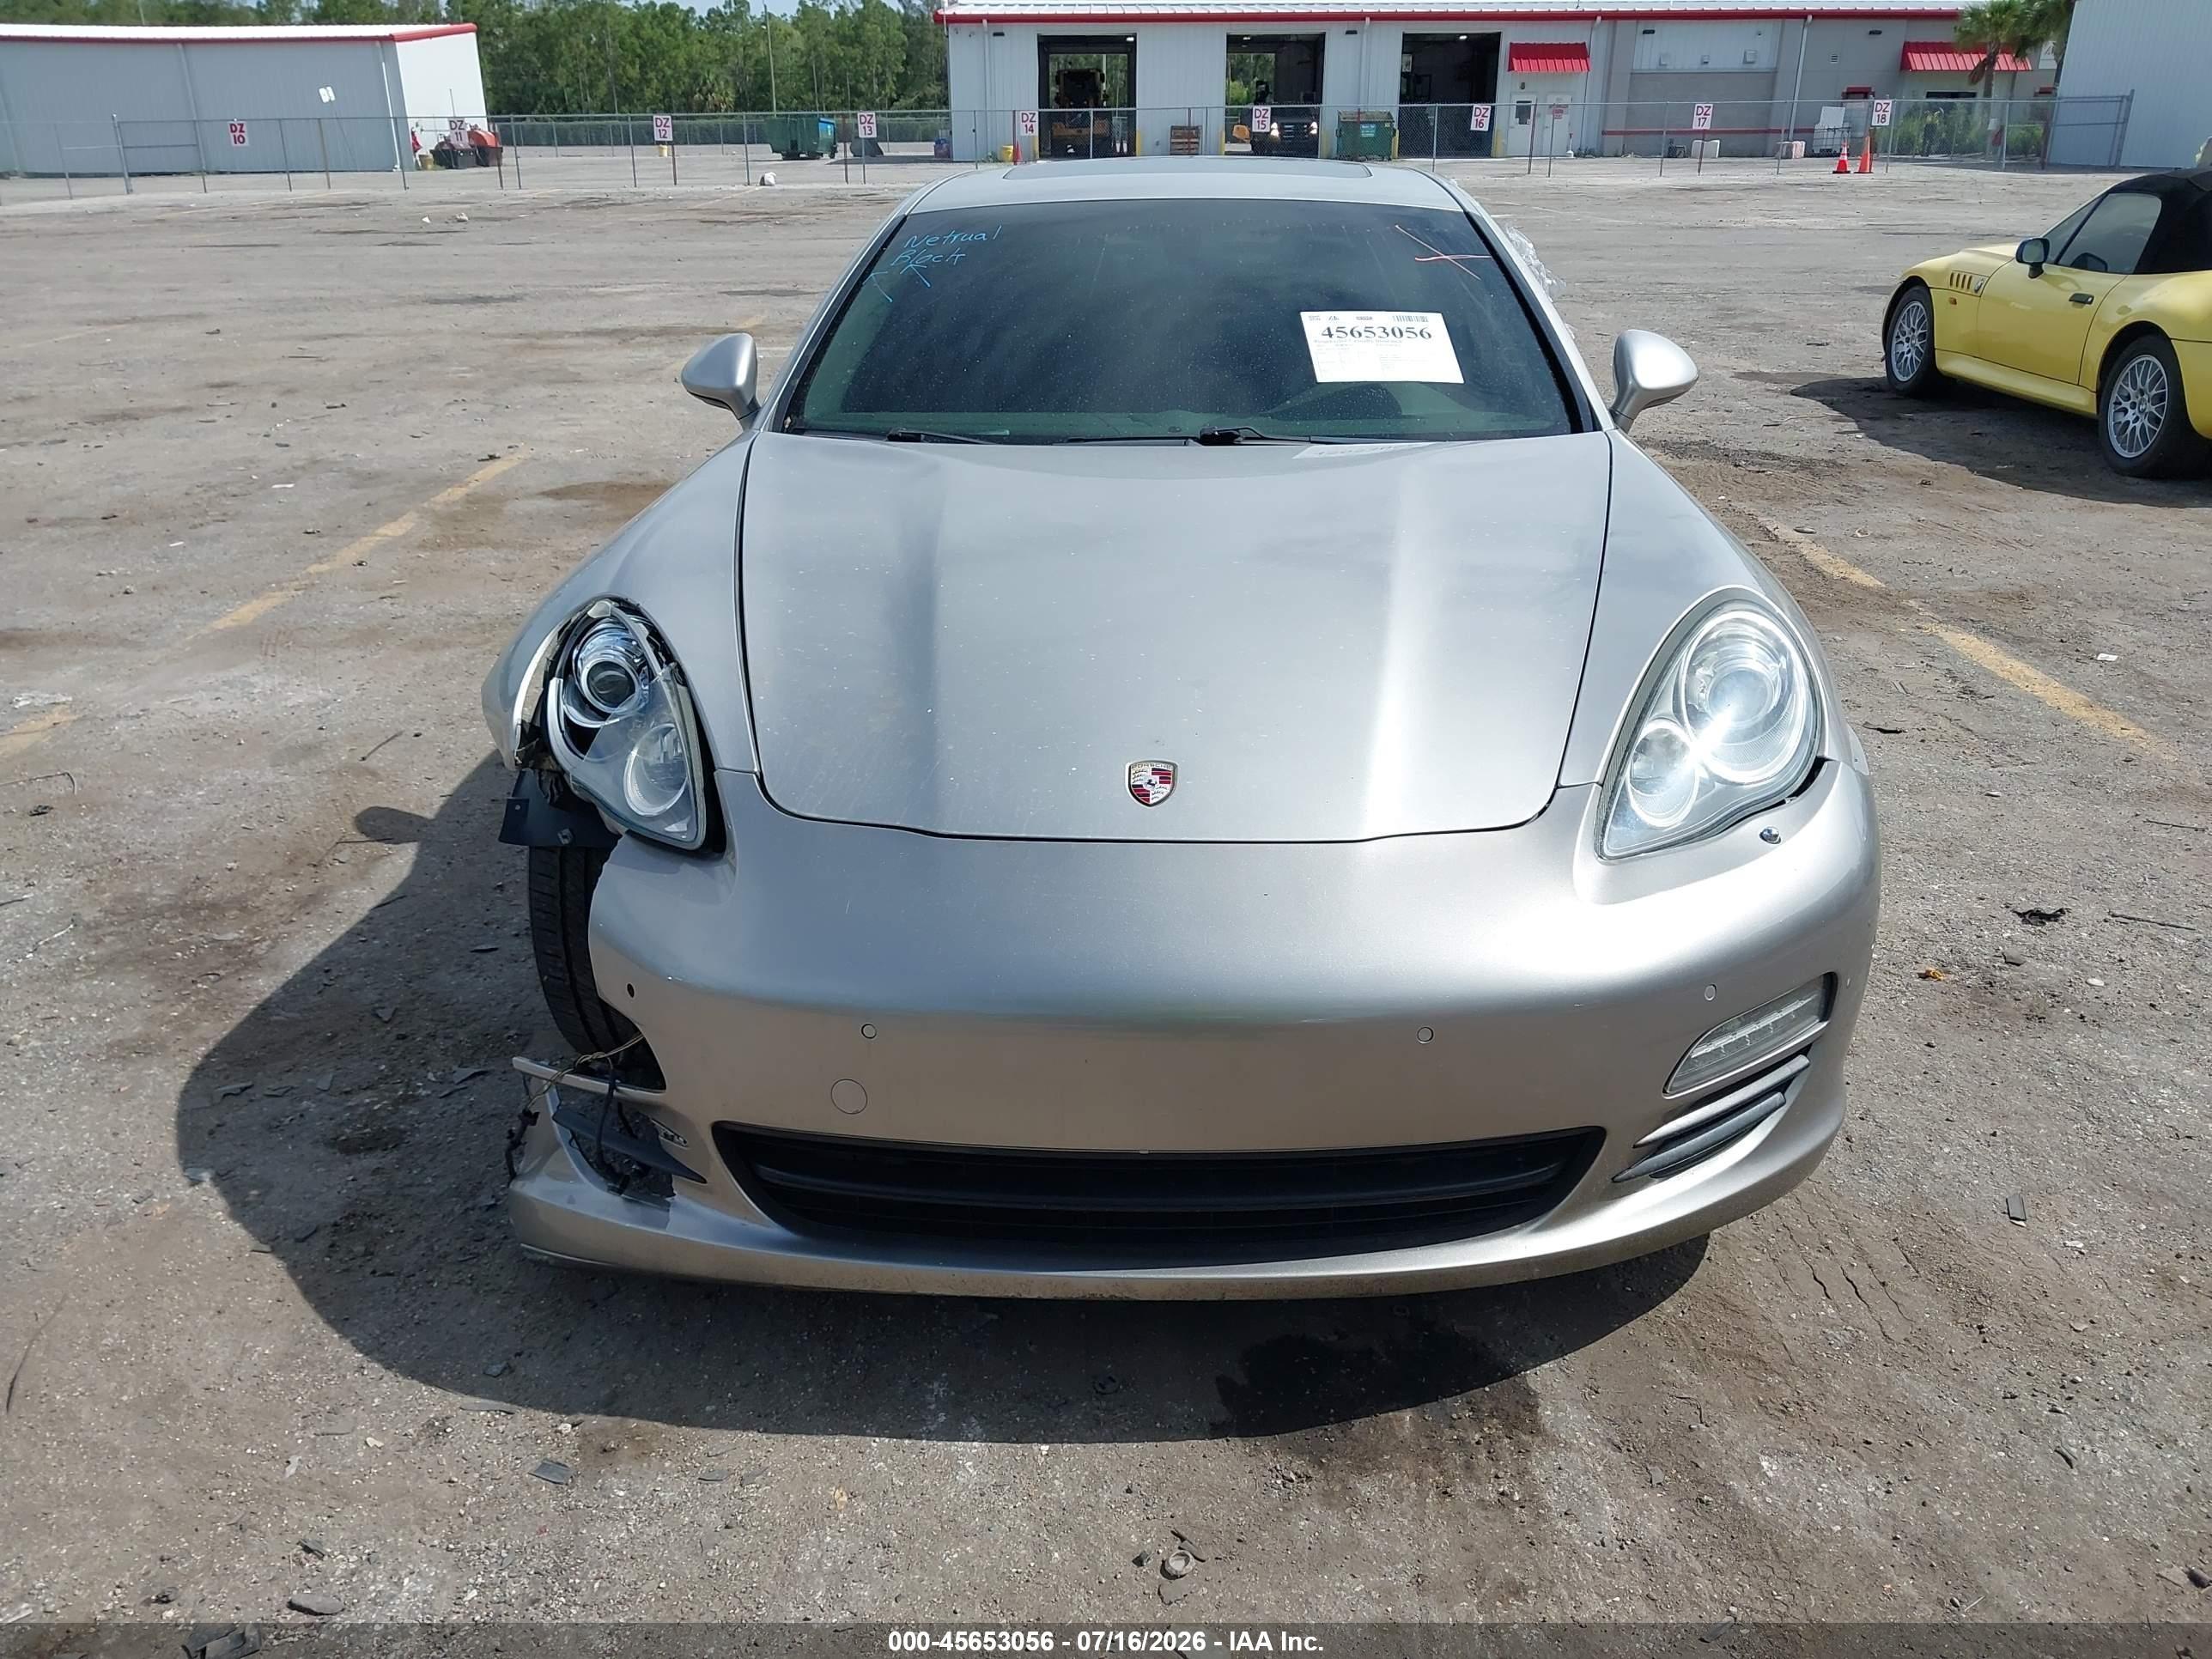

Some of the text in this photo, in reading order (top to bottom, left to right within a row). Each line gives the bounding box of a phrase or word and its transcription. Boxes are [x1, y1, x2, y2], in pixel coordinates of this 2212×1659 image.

[1696, 106, 1711, 116] DZ
[1875, 102, 1891, 112] DZ
[1021, 112, 1036, 123] DZ
[1254, 108, 1269, 118] DZ
[1474, 107, 1490, 118] DZ
[654, 118, 671, 128] DZ
[859, 114, 874, 125] DZ
[1475, 118, 1485, 128] 16
[1698, 117, 1707, 127] 17
[1876, 113, 1887, 124] 18
[229, 123, 245, 133] DZ
[449, 119, 465, 131] DZ
[1024, 124, 1034, 134] 14
[1256, 119, 1267, 130] 15
[658, 129, 668, 138] 12
[862, 125, 872, 136] 13
[233, 134, 246, 144] 10
[454, 131, 462, 142] 11
[1321, 325, 1432, 340] 45653056
